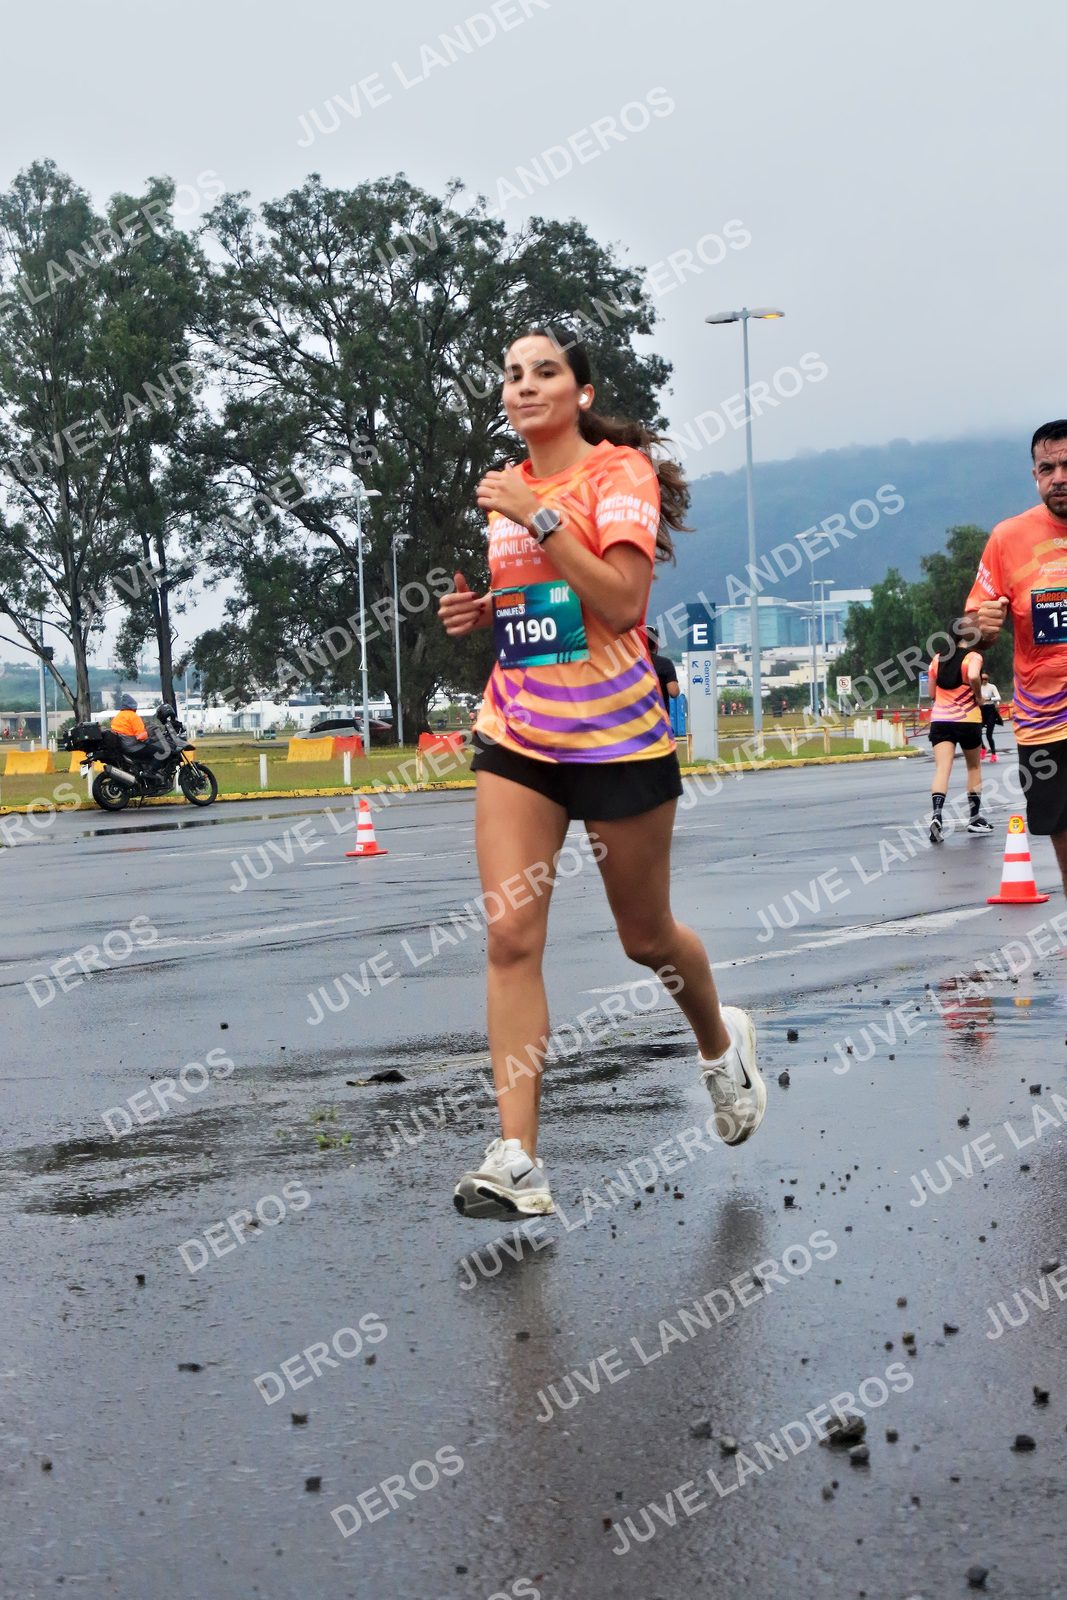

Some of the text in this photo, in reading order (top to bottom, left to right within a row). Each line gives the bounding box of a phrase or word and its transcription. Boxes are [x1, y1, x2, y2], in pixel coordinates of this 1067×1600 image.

[549, 586, 570, 604] 10K
[504, 617, 557, 645] 1190
[693, 623, 708, 645] E
